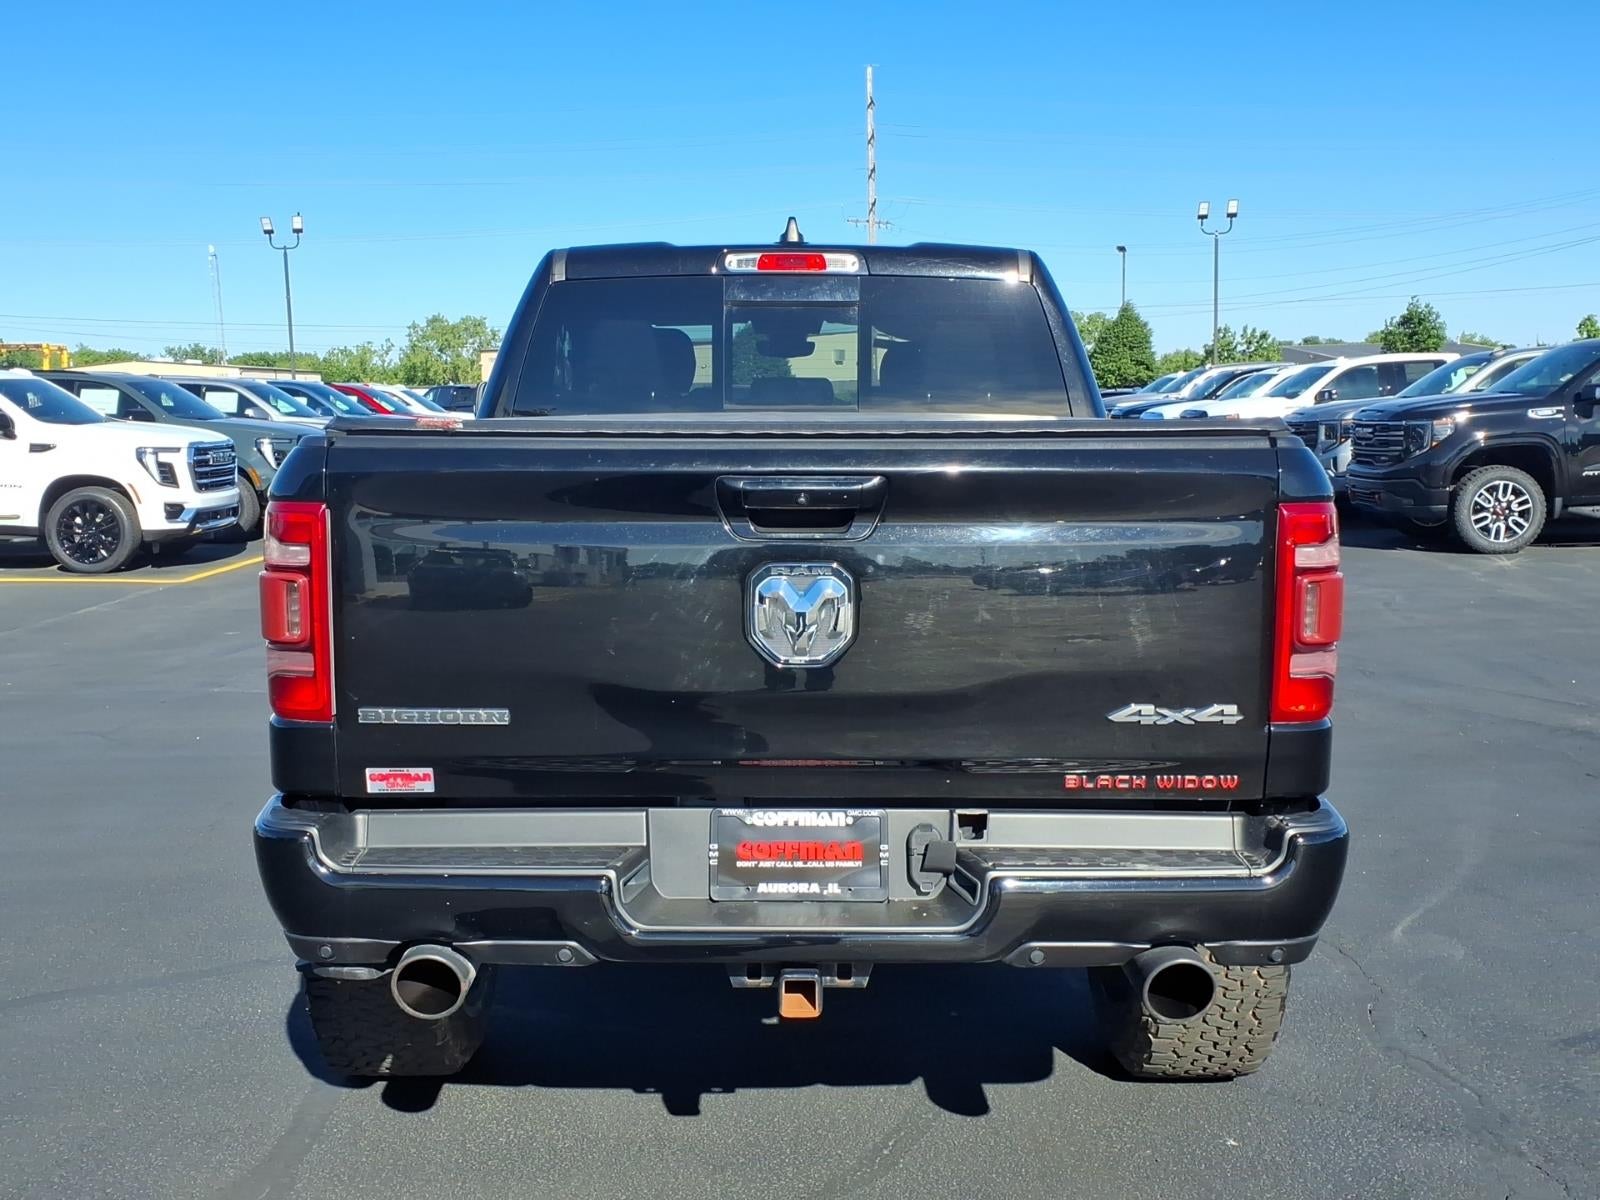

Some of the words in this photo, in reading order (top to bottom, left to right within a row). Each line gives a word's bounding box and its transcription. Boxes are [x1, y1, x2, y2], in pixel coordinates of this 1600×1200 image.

[770, 566, 832, 576] RAM
[1064, 775, 1146, 791] BLACK
[1156, 775, 1240, 791] WIDOW
[752, 811, 846, 827] COFFMAN
[736, 840, 864, 861] COFFMAN
[758, 860, 775, 868] JUST
[776, 860, 793, 868] CALL
[825, 860, 834, 868] US
[757, 882, 820, 893] AURORA
